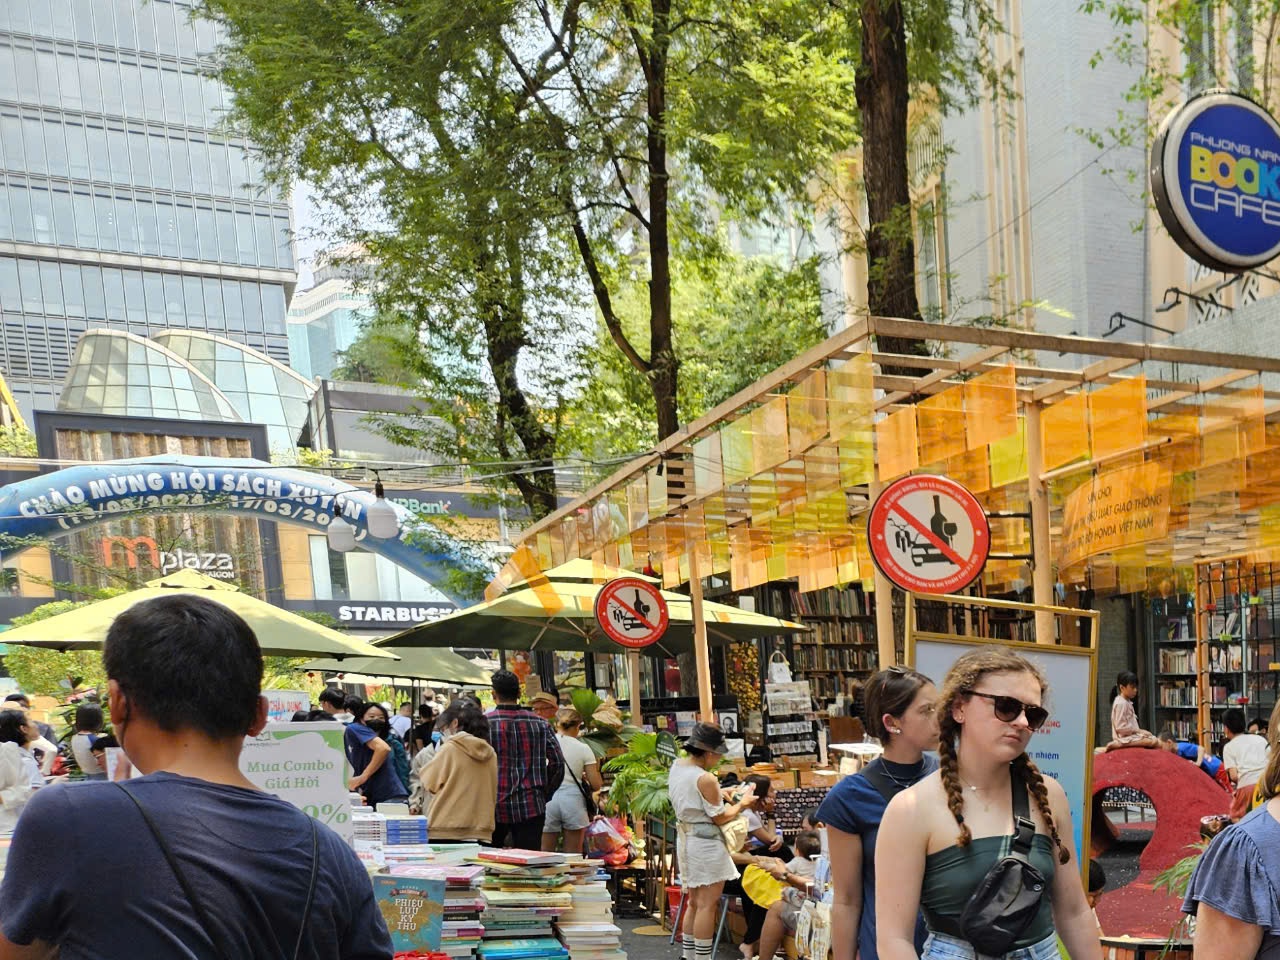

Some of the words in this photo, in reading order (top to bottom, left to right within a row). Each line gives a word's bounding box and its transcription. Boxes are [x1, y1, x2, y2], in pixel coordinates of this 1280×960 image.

[88, 471, 165, 500] MỪNG
[170, 468, 216, 492] HỘI
[222, 472, 282, 498] SÁCH
[247, 761, 280, 773] Mua
[283, 759, 335, 772] Combo
[265, 778, 290, 789] Giá
[293, 777, 320, 789] Hời
